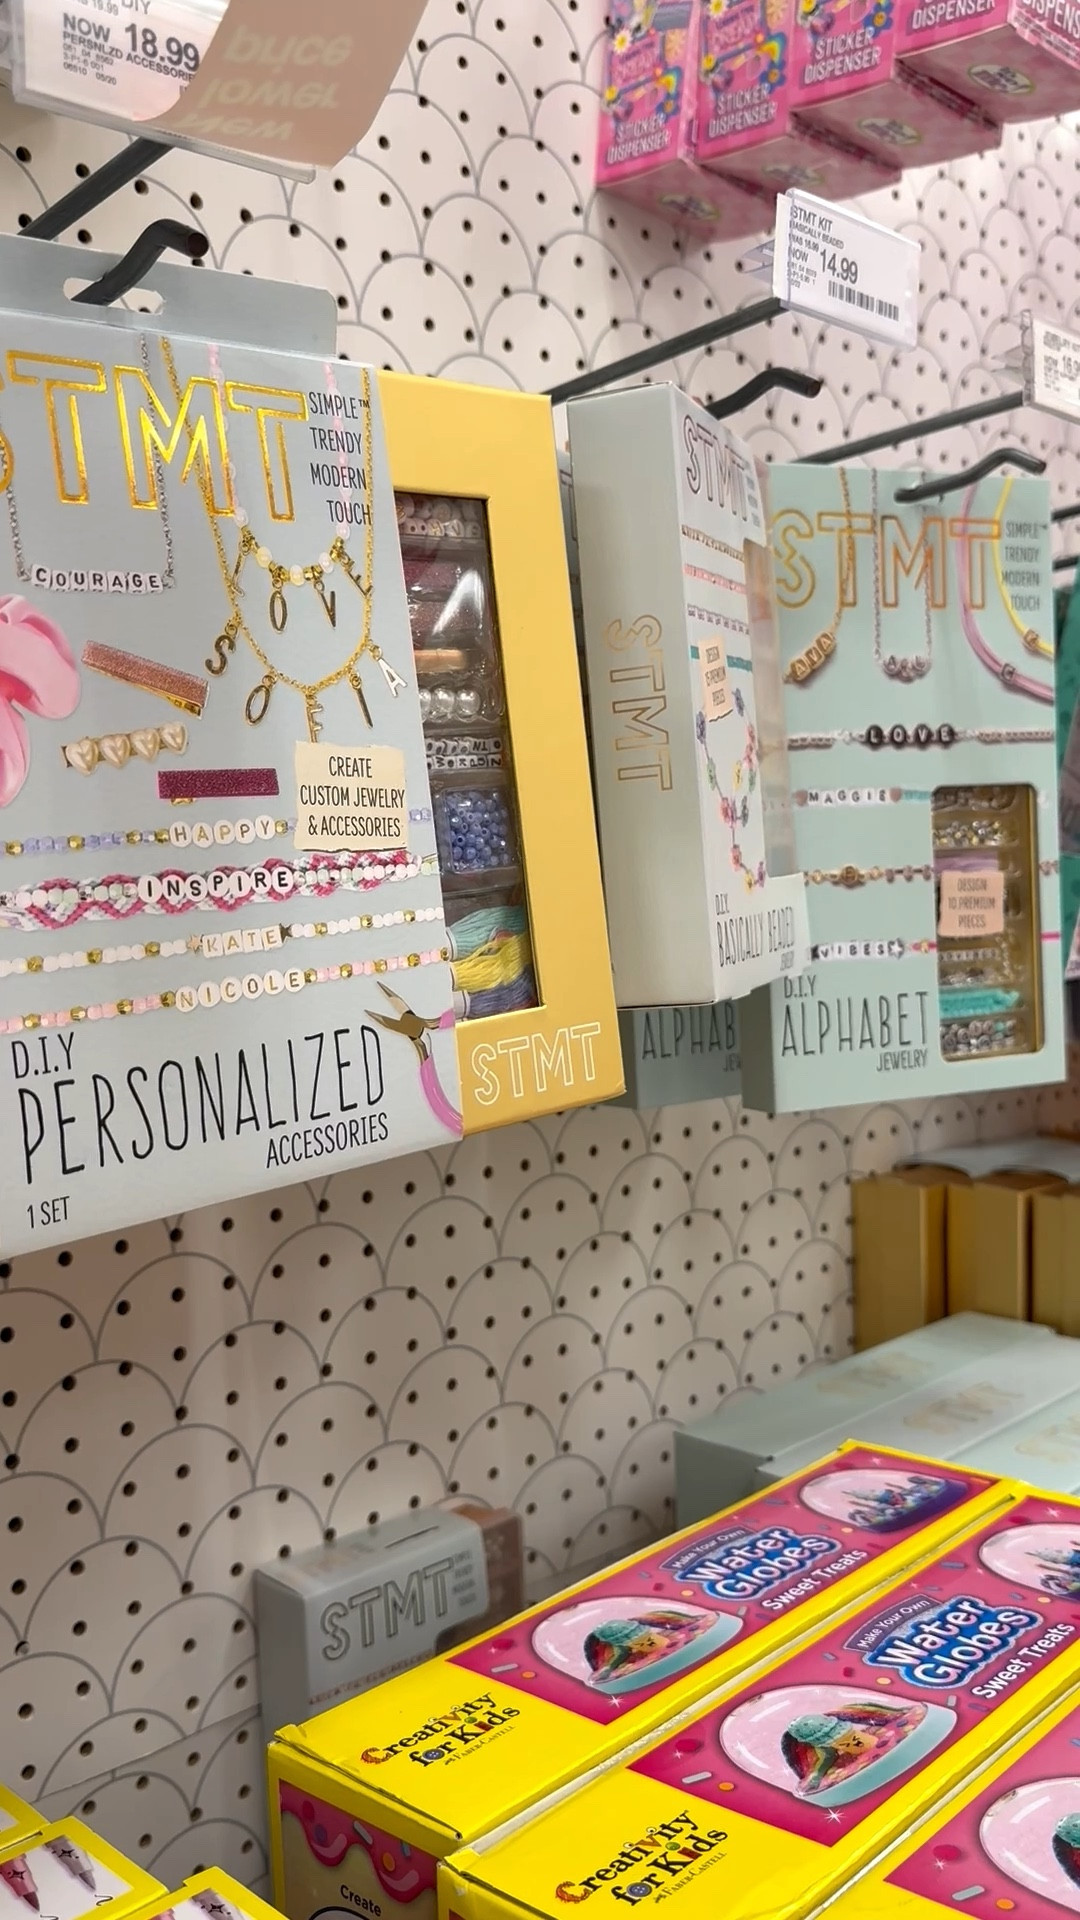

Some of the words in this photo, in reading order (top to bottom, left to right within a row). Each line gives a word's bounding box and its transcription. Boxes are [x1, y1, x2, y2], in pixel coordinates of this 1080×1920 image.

[62, 31, 123, 60] PERSNLZD
[63, 12, 111, 43] NOW
[125, 22, 200, 72] 18.99
[815, 27, 875, 59] STICKER
[804, 47, 881, 84] DISPENSER
[717, 84, 770, 115] STICKER
[616, 113, 666, 143] STICKER
[708, 102, 777, 138] DISPENSER
[607, 130, 671, 165] DISPENSER
[789, 220, 821, 239] BASICALLY
[822, 233, 844, 249] BEADED
[790, 205, 817, 226] STMT
[818, 216, 833, 233] KIT
[788, 247, 809, 263] NOW
[820, 249, 858, 284] 14.99
[0, 350, 308, 522] TMT
[310, 427, 362, 454] TRENDY
[310, 463, 366, 490] MODERN
[683, 414, 748, 522] STMT
[326, 500, 372, 526] TOUCH
[770, 508, 1002, 610] STMT
[1004, 547, 1040, 562] TRENDY
[34, 567, 160, 590] COURAGE
[1001, 570, 1040, 587] MODERN
[1010, 594, 1040, 611] TOUCH
[792, 635, 834, 678] AVA
[605, 614, 673, 792] STMT
[869, 727, 950, 742] LOVE
[329, 756, 373, 778] CREATE
[300, 786, 350, 808] CUSTOM
[353, 785, 405, 809] JEWELRY
[809, 789, 886, 804] MAGGIE
[174, 818, 271, 843] HAPPY
[308, 816, 319, 837] &
[320, 816, 401, 838] ACCESSORIES
[146, 870, 290, 898] INSPIRE
[957, 878, 987, 892] DESIGN
[958, 896, 995, 910] PREMIUM
[958, 914, 986, 929] PIECES
[207, 929, 279, 955] KATE
[820, 943, 884, 958] VIBES
[180, 971, 301, 1008] NICOLE
[781, 991, 928, 1057] ALPHABET
[12, 1032, 75, 1079] D.I.Y
[472, 1022, 601, 1106] STMT
[876, 1049, 928, 1073] JEWELRY
[18, 1025, 385, 1185] PERSONALIZED
[266, 1112, 389, 1169] ACCESSORIES
[27, 1204, 35, 1229] 1
[40, 1196, 70, 1227] SET
[672, 1551, 694, 1569] Make
[693, 1538, 717, 1555] Your
[717, 1528, 746, 1543] Own
[686, 1528, 791, 1582] Water
[715, 1537, 831, 1597] Globes
[761, 1577, 821, 1610] Sweet
[811, 1549, 868, 1579] Treats
[321, 1556, 454, 1661] STMT
[857, 1627, 882, 1649] Make
[877, 1613, 903, 1629] Your
[901, 1599, 931, 1616] Own
[876, 1600, 984, 1666] Water
[913, 1610, 1031, 1684] Globes
[972, 1656, 1034, 1700] Sweet
[1018, 1623, 1076, 1659] Treats
[361, 1692, 496, 1765] Creativity
[409, 1741, 457, 1767] for
[444, 1707, 521, 1745] Kids
[555, 1810, 699, 1904] Creativity
[611, 1871, 665, 1907] for
[646, 1829, 728, 1877] Kids
[339, 1884, 383, 1916] Create
